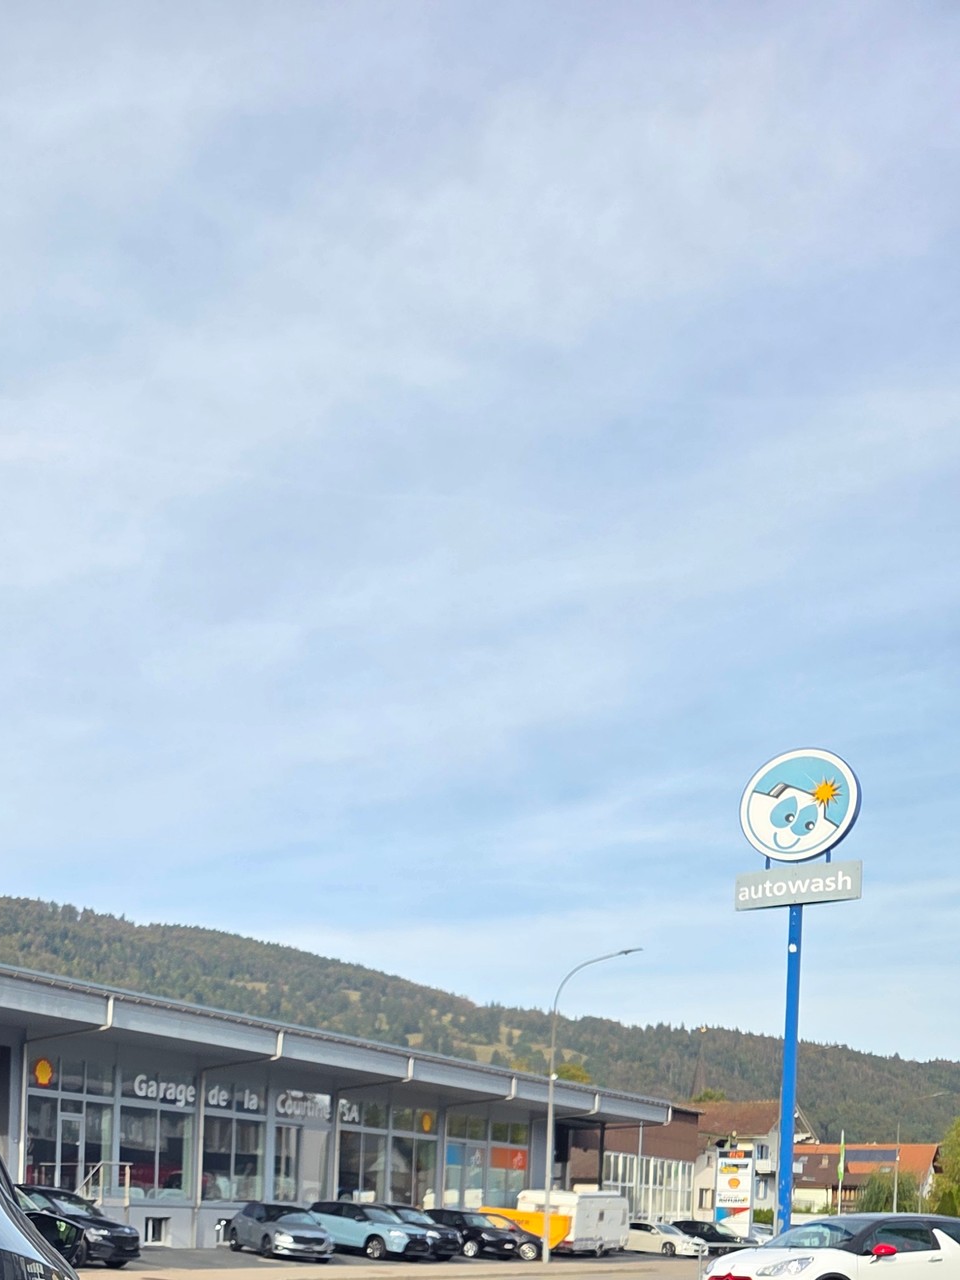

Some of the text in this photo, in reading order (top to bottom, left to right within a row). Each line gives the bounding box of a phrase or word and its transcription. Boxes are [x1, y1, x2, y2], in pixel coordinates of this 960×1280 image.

[738, 870, 852, 901] autowash
[134, 1074, 196, 1108] Garage
[208, 1085, 228, 1106] de
[244, 1089, 258, 1110] la
[341, 1100, 359, 1122] SA
